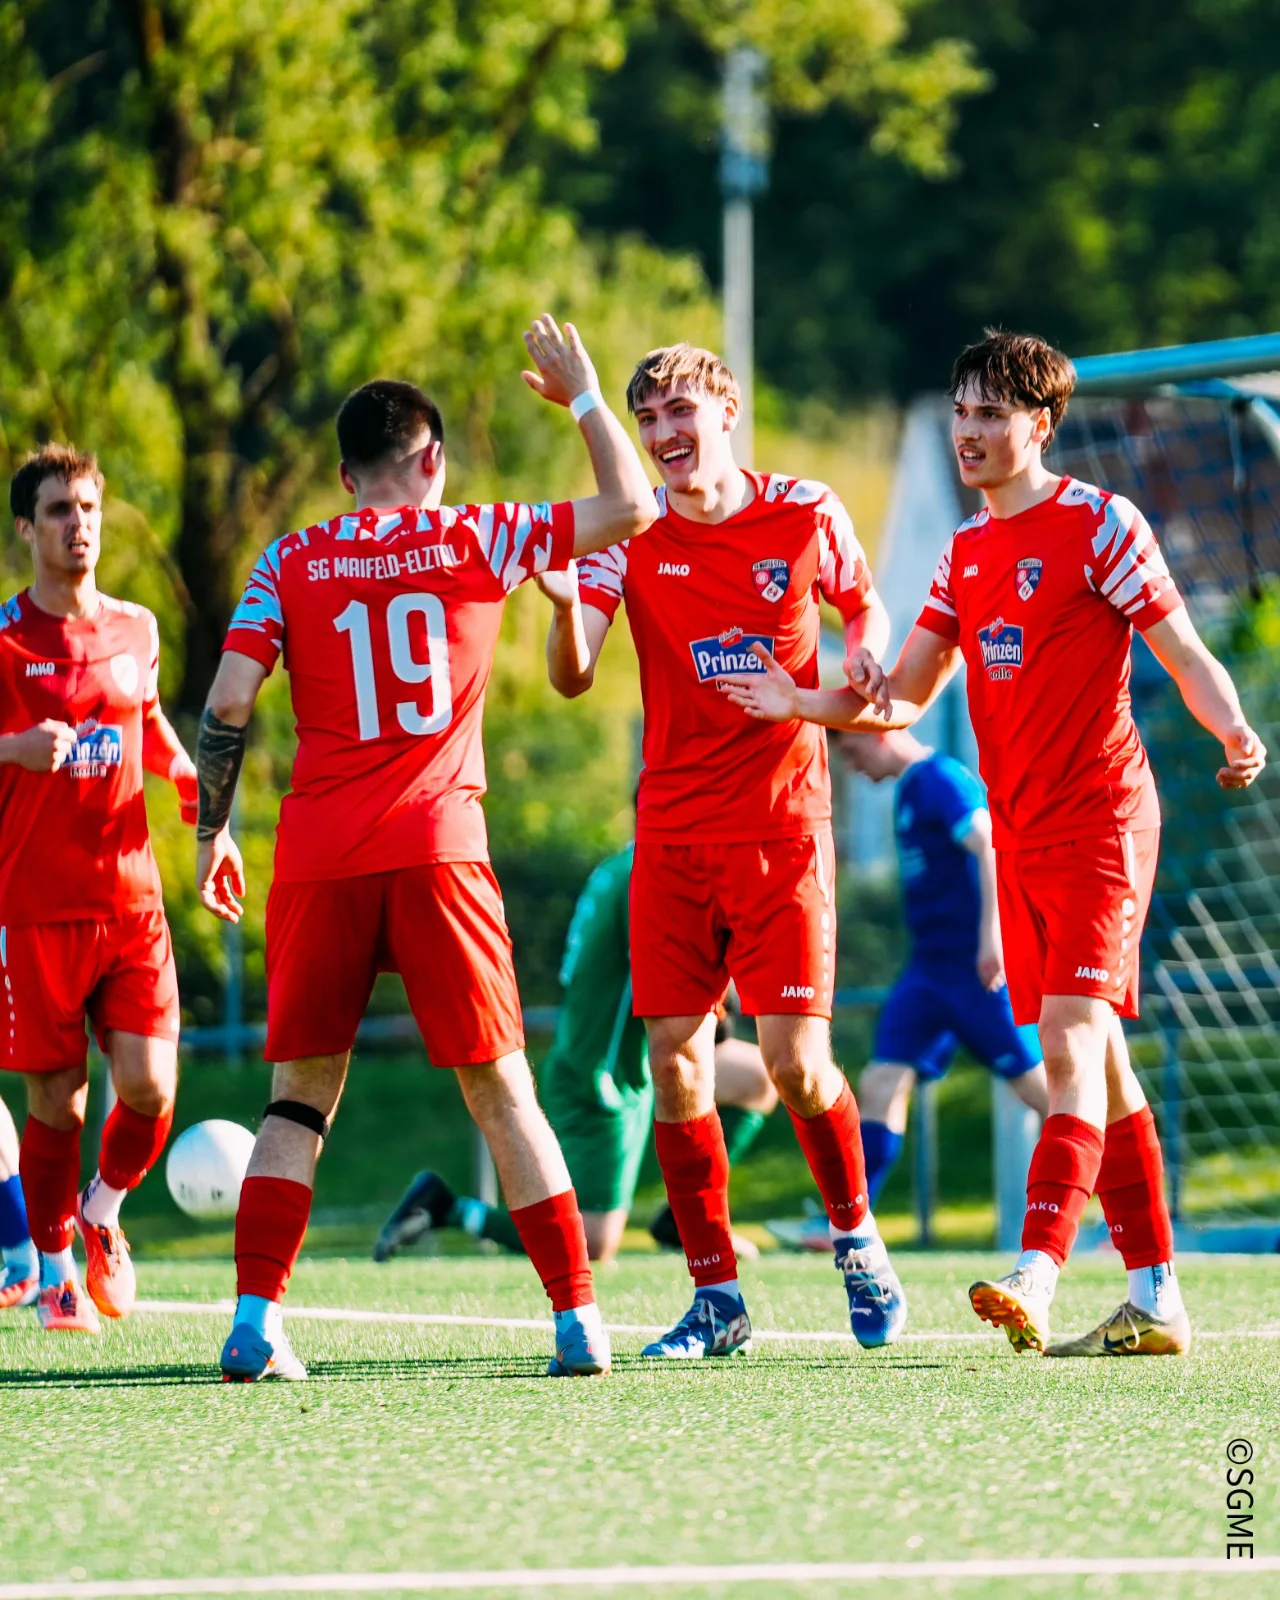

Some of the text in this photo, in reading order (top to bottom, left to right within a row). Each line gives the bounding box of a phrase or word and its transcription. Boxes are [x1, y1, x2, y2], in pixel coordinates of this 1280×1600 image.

[307, 543, 462, 581] SG MAIFELD-ELZTAL
[657, 562, 691, 577] JAKO
[963, 564, 978, 578] JAKO
[981, 640, 1020, 665] Prinzen
[25, 661, 56, 677] JAKO
[332, 592, 454, 741] 19
[1074, 965, 1109, 983] JAKO
[780, 985, 815, 999] JAKO
